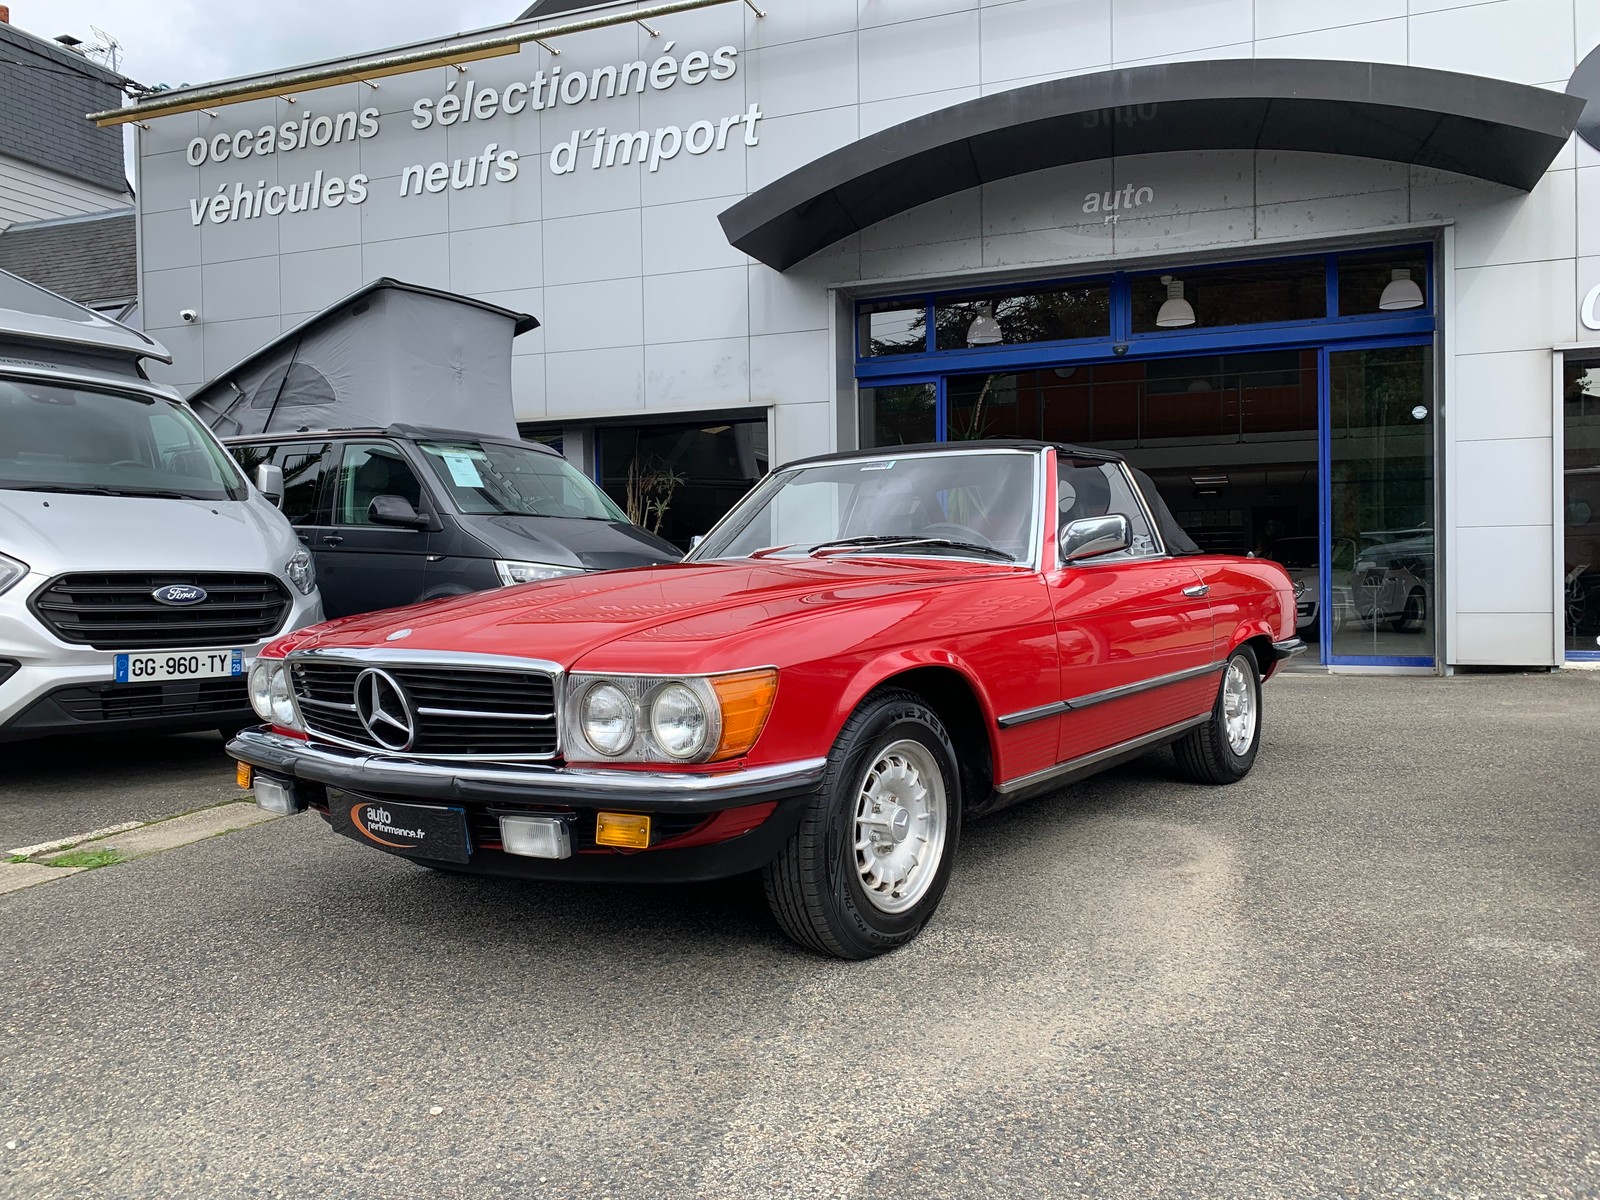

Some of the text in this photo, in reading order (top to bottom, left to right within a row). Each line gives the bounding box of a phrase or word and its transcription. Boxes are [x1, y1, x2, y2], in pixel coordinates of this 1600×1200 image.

[185, 40, 737, 167] occasions sélectionnées
[188, 170, 368, 227] véhicules
[399, 141, 519, 197] neufs
[1082, 183, 1154, 213] auto
[167, 587, 197, 600] Ford
[132, 654, 228, 677] GG-960-TY
[232, 663, 241, 672] 29
[888, 706, 949, 748] NEXEN
[367, 807, 391, 824] auto
